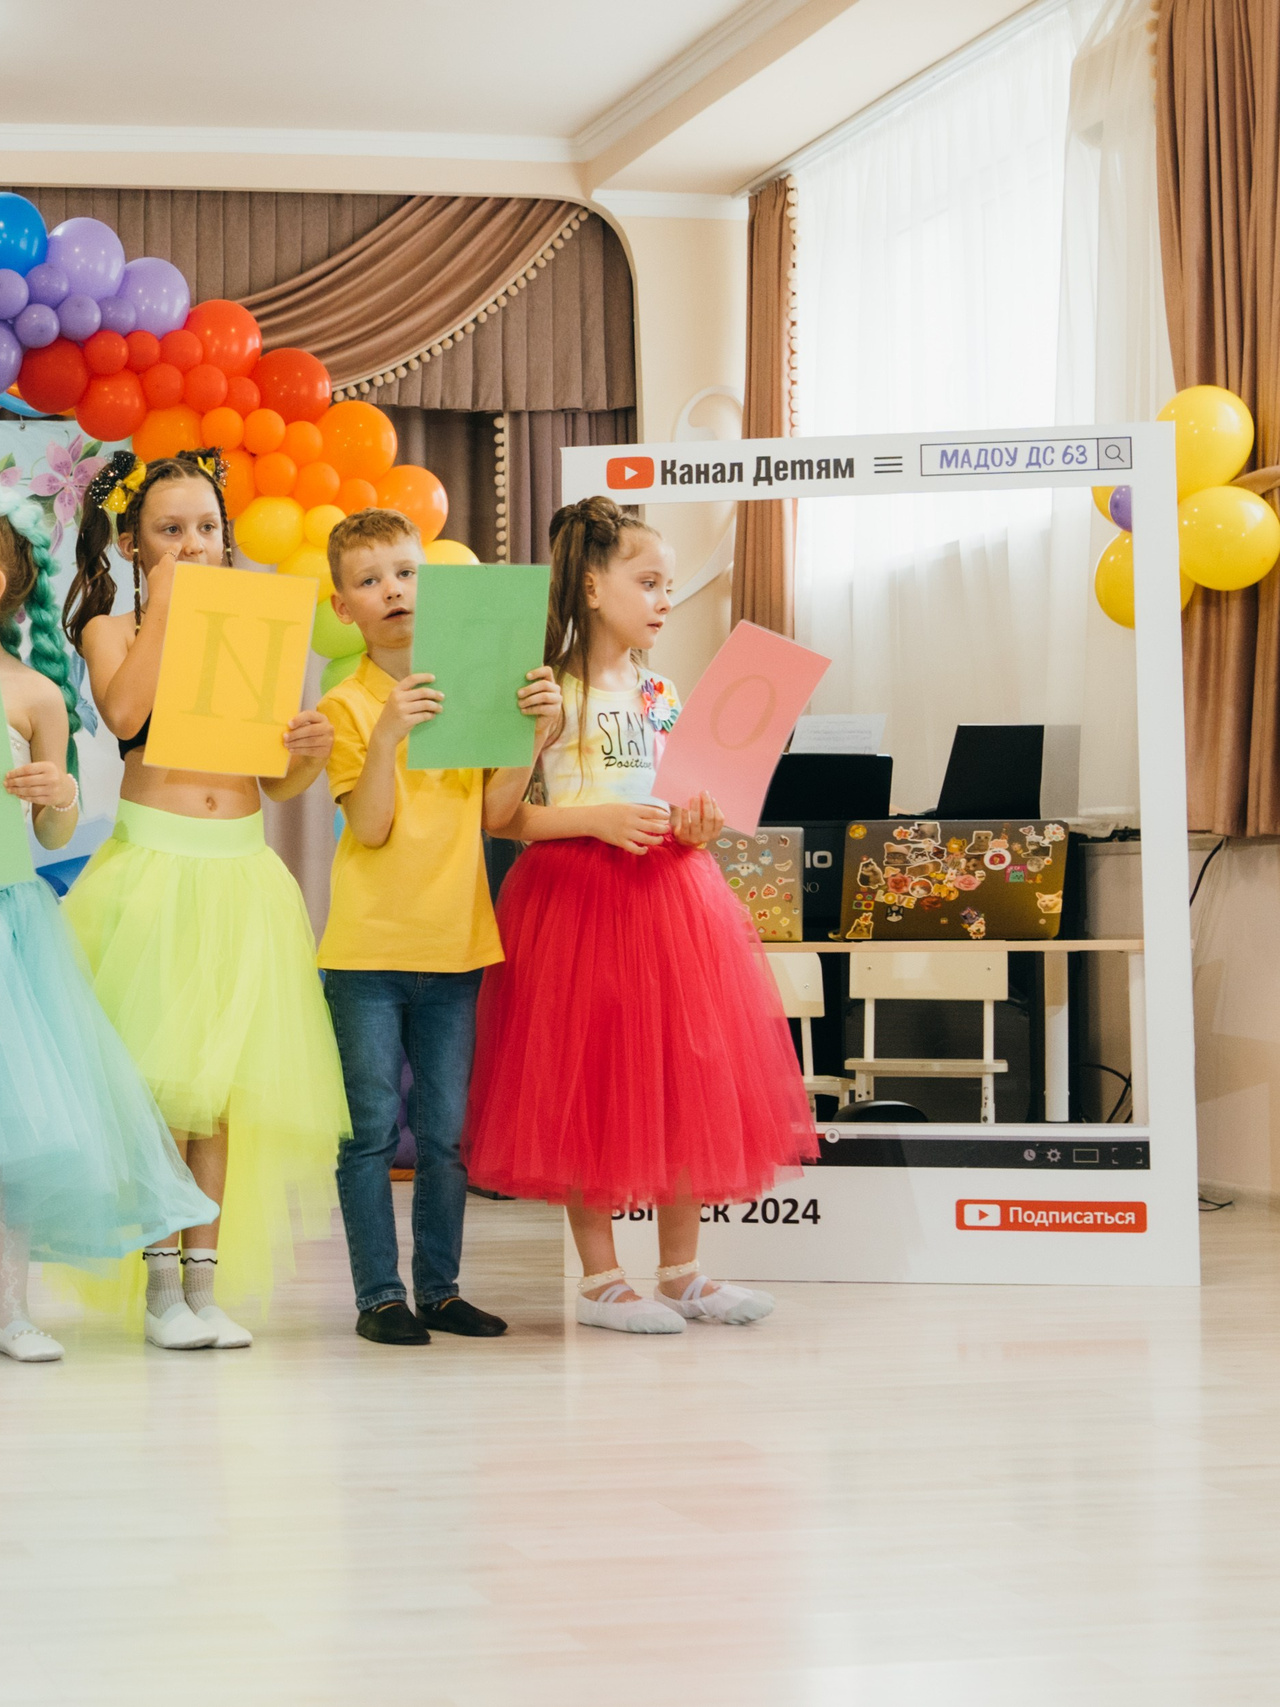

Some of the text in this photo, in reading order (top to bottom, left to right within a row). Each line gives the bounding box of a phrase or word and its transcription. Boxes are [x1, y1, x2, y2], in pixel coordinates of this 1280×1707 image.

[661, 455, 855, 487] Канал Детям
[939, 444, 1088, 471] МАДОУ ДС 63
[597, 710, 647, 757] STAY
[875, 889, 917, 909] LOVE
[741, 1197, 821, 1224] 2024
[1008, 1206, 1136, 1227] Подписаться
